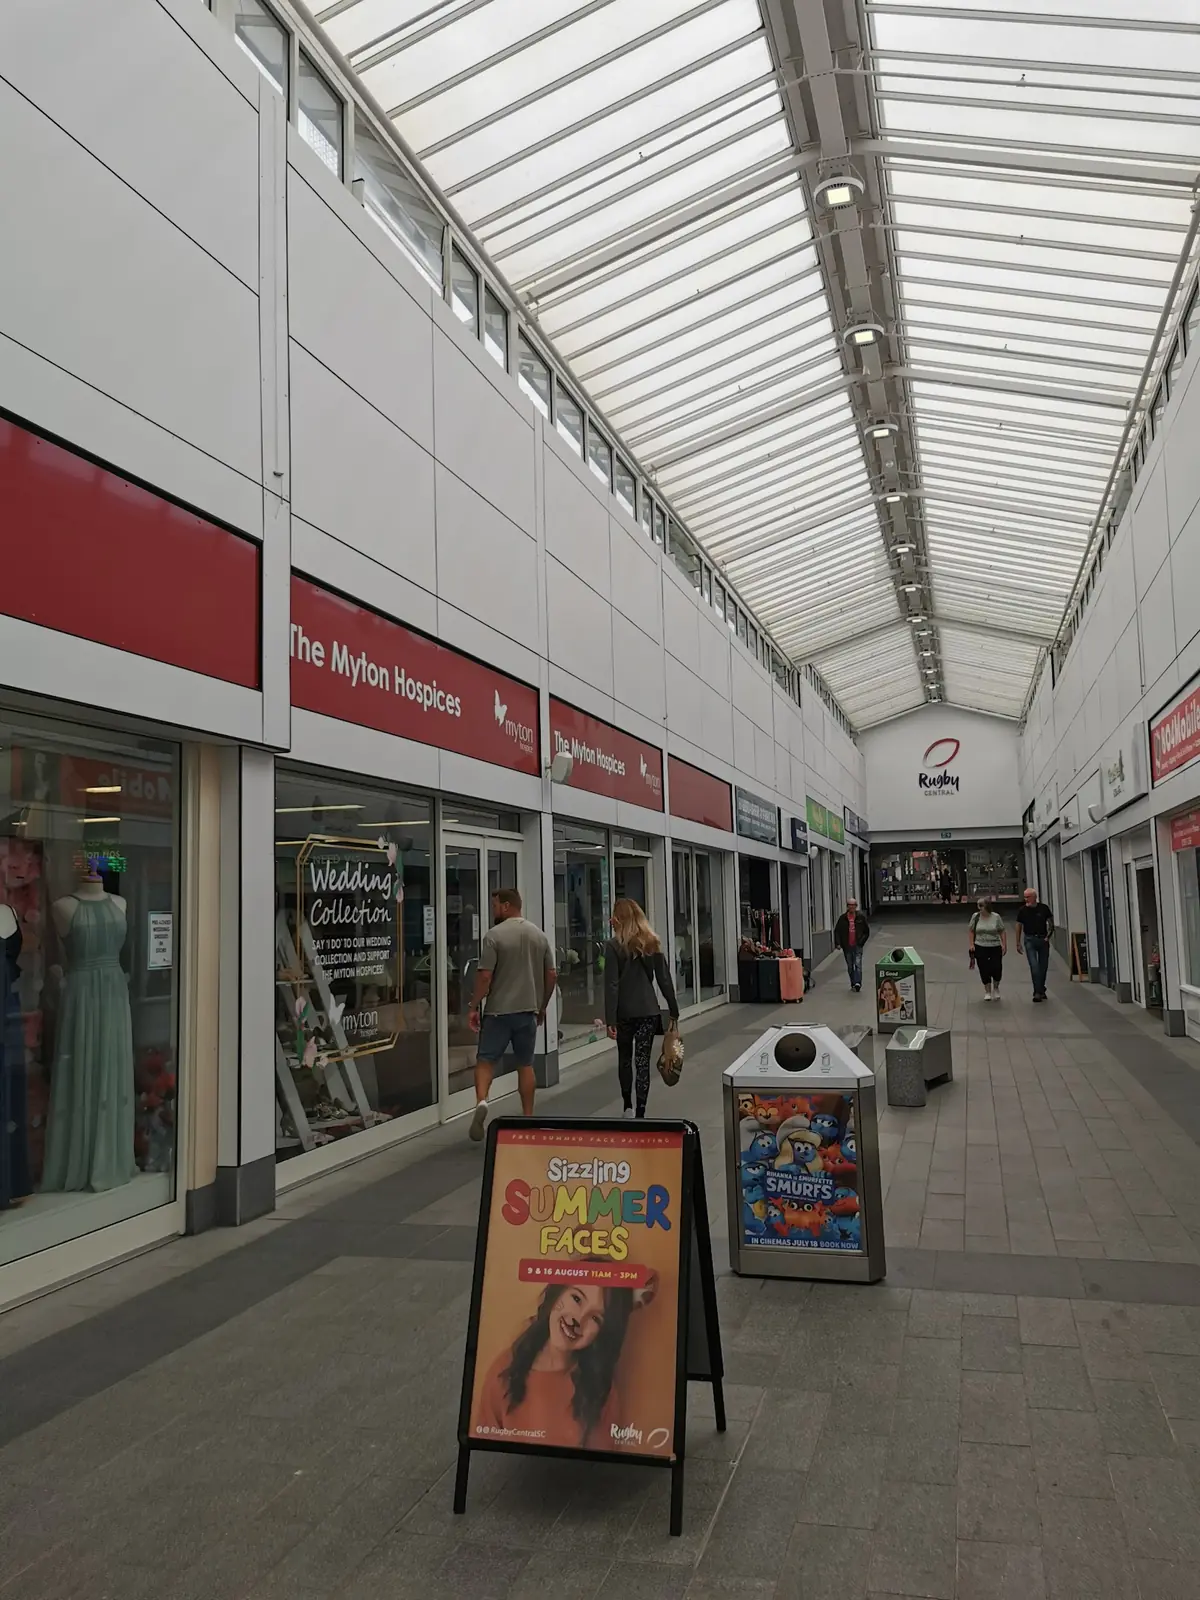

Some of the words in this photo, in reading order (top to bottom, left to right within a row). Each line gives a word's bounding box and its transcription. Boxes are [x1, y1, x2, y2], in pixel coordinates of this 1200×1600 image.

[290, 623, 325, 667] The
[331, 640, 389, 691] Myton
[394, 665, 461, 717] Hospices
[505, 719, 533, 743] myton
[554, 730, 569, 752] The
[571, 737, 595, 765] Myton
[596, 748, 625, 776] Hospices
[918, 769, 959, 791] Rugby
[311, 860, 392, 900] Wedding
[311, 898, 392, 926] Collection
[312, 940, 325, 950] SAY
[344, 938, 352, 948] TO
[353, 937, 365, 948] OUR
[366, 936, 391, 947] WEDDING
[315, 953, 352, 965] COLLECTION
[353, 952, 366, 962] AND
[367, 950, 390, 961] SUPPORT
[322, 969, 332, 981] THE
[333, 967, 355, 979] MYTON
[343, 1011, 378, 1035] myton
[511, 1133, 536, 1141] FREE
[547, 1156, 631, 1186] Sizzling
[766, 1171, 792, 1180] RIHANNA
[798, 1175, 833, 1186] SMURFETTE
[766, 1177, 833, 1200] SMURFS
[501, 1178, 672, 1231] SUMMER
[540, 1225, 629, 1261] FACES
[760, 1238, 791, 1246] CINEMAS
[791, 1239, 809, 1247] JULY
[535, 1267, 541, 1275] &
[543, 1267, 553, 1275] 16
[555, 1268, 589, 1277] AUGUST
[591, 1270, 612, 1278] 11AM
[619, 1271, 638, 1280] 3PM
[490, 1426, 546, 1438] RugbyCentralSC
[610, 1422, 642, 1444] Rugby
